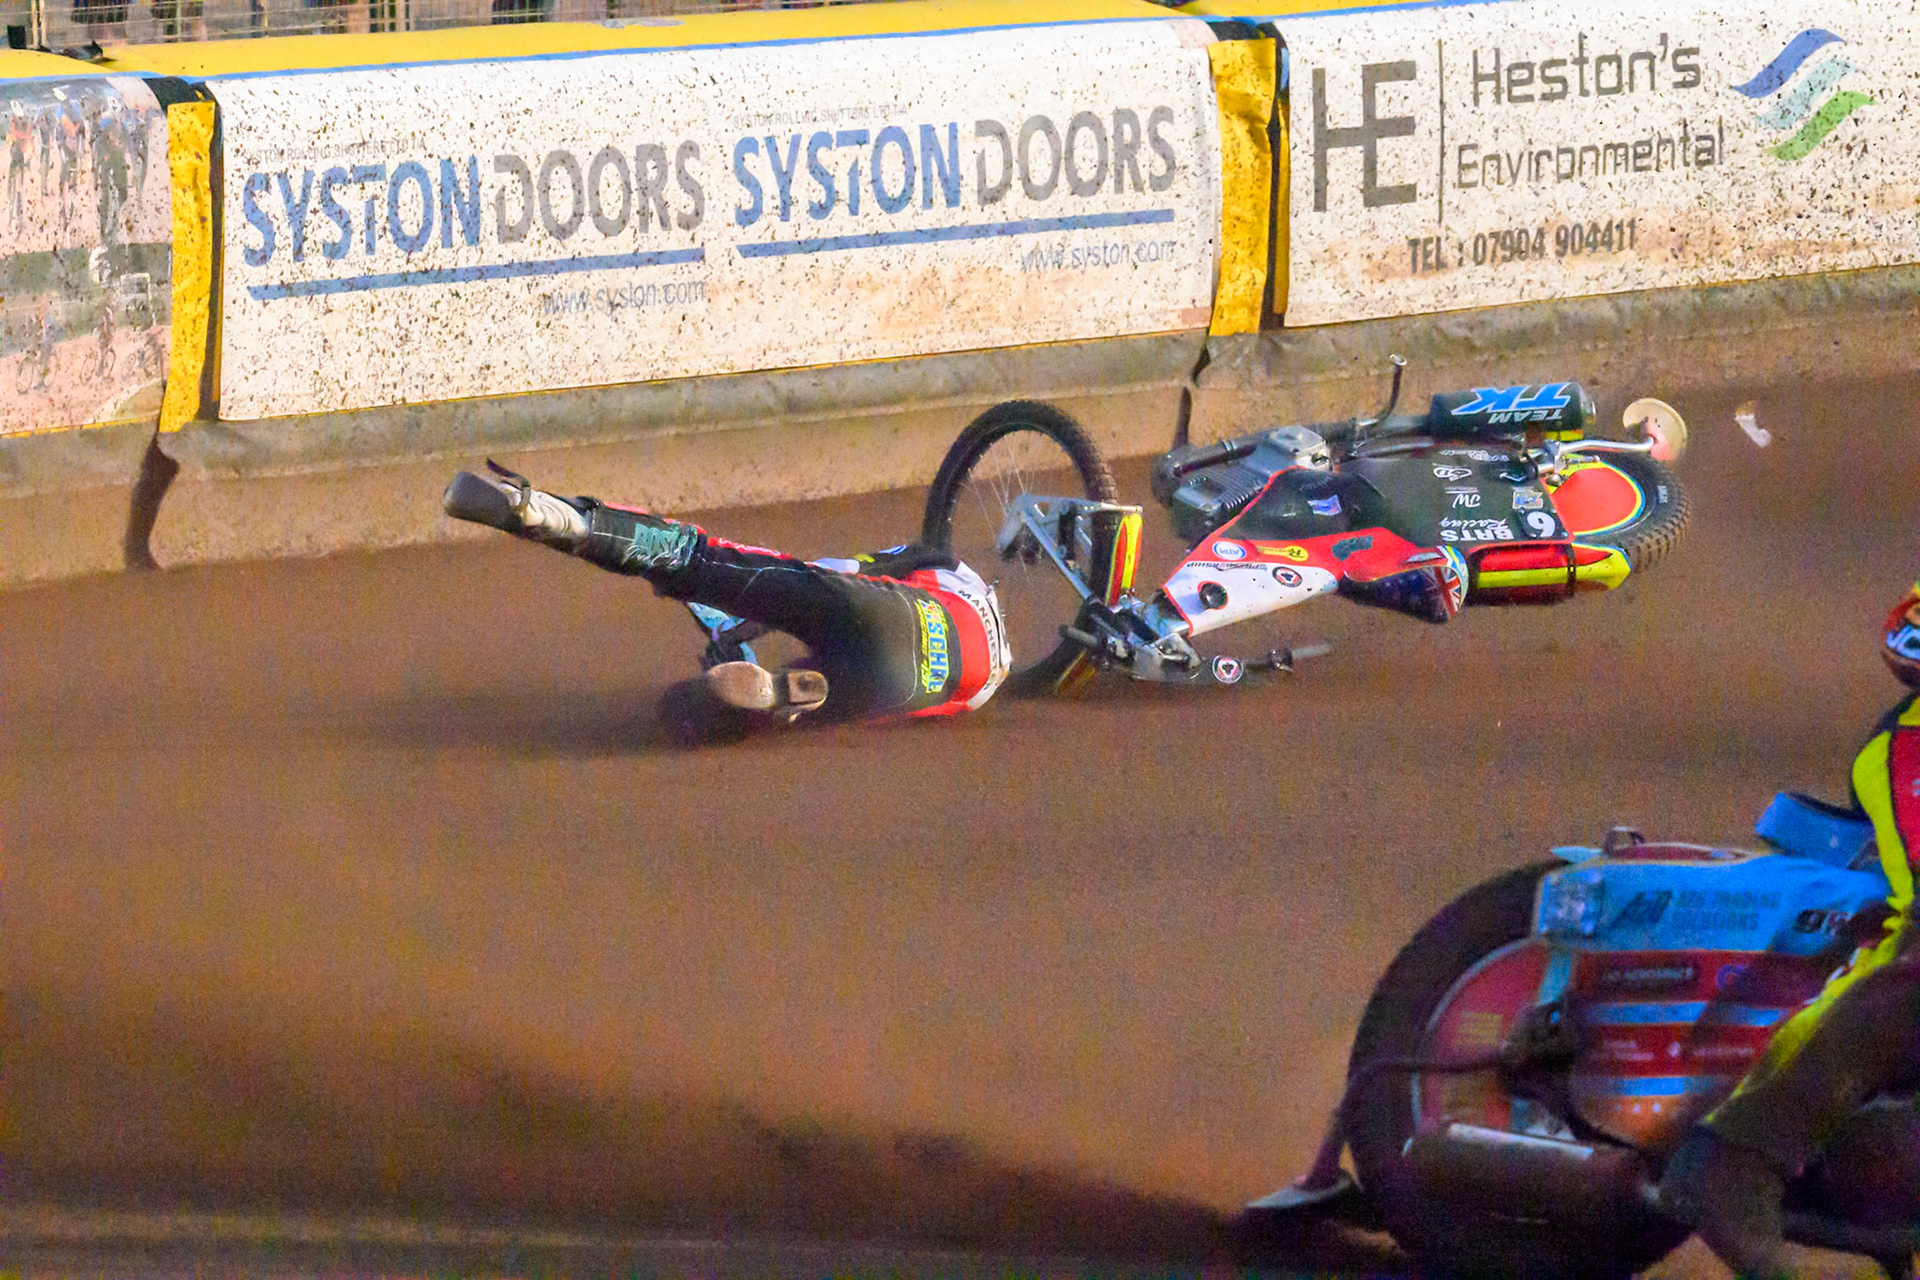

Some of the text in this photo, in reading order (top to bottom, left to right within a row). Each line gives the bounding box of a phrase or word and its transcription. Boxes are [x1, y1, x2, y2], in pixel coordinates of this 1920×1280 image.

[1473, 33, 1700, 106] Heston's
[733, 105, 1177, 227] SYSTON DOORS
[1457, 116, 1724, 189] Environmental
[243, 140, 706, 267] SYSTON DOORS
[1021, 238, 1176, 273] www.syston.com
[1407, 235, 1447, 274] TEL
[1473, 227, 1547, 266] 07904
[1555, 217, 1636, 258] 904411
[542, 279, 706, 318] www.syston.com
[1451, 382, 1572, 416] TK
[1488, 408, 1563, 424] TEAM
[1439, 517, 1508, 531] Racing
[1440, 529, 1515, 541] BRTS
[1526, 511, 1556, 538] 6
[957, 589, 999, 691] MANCHESTR
